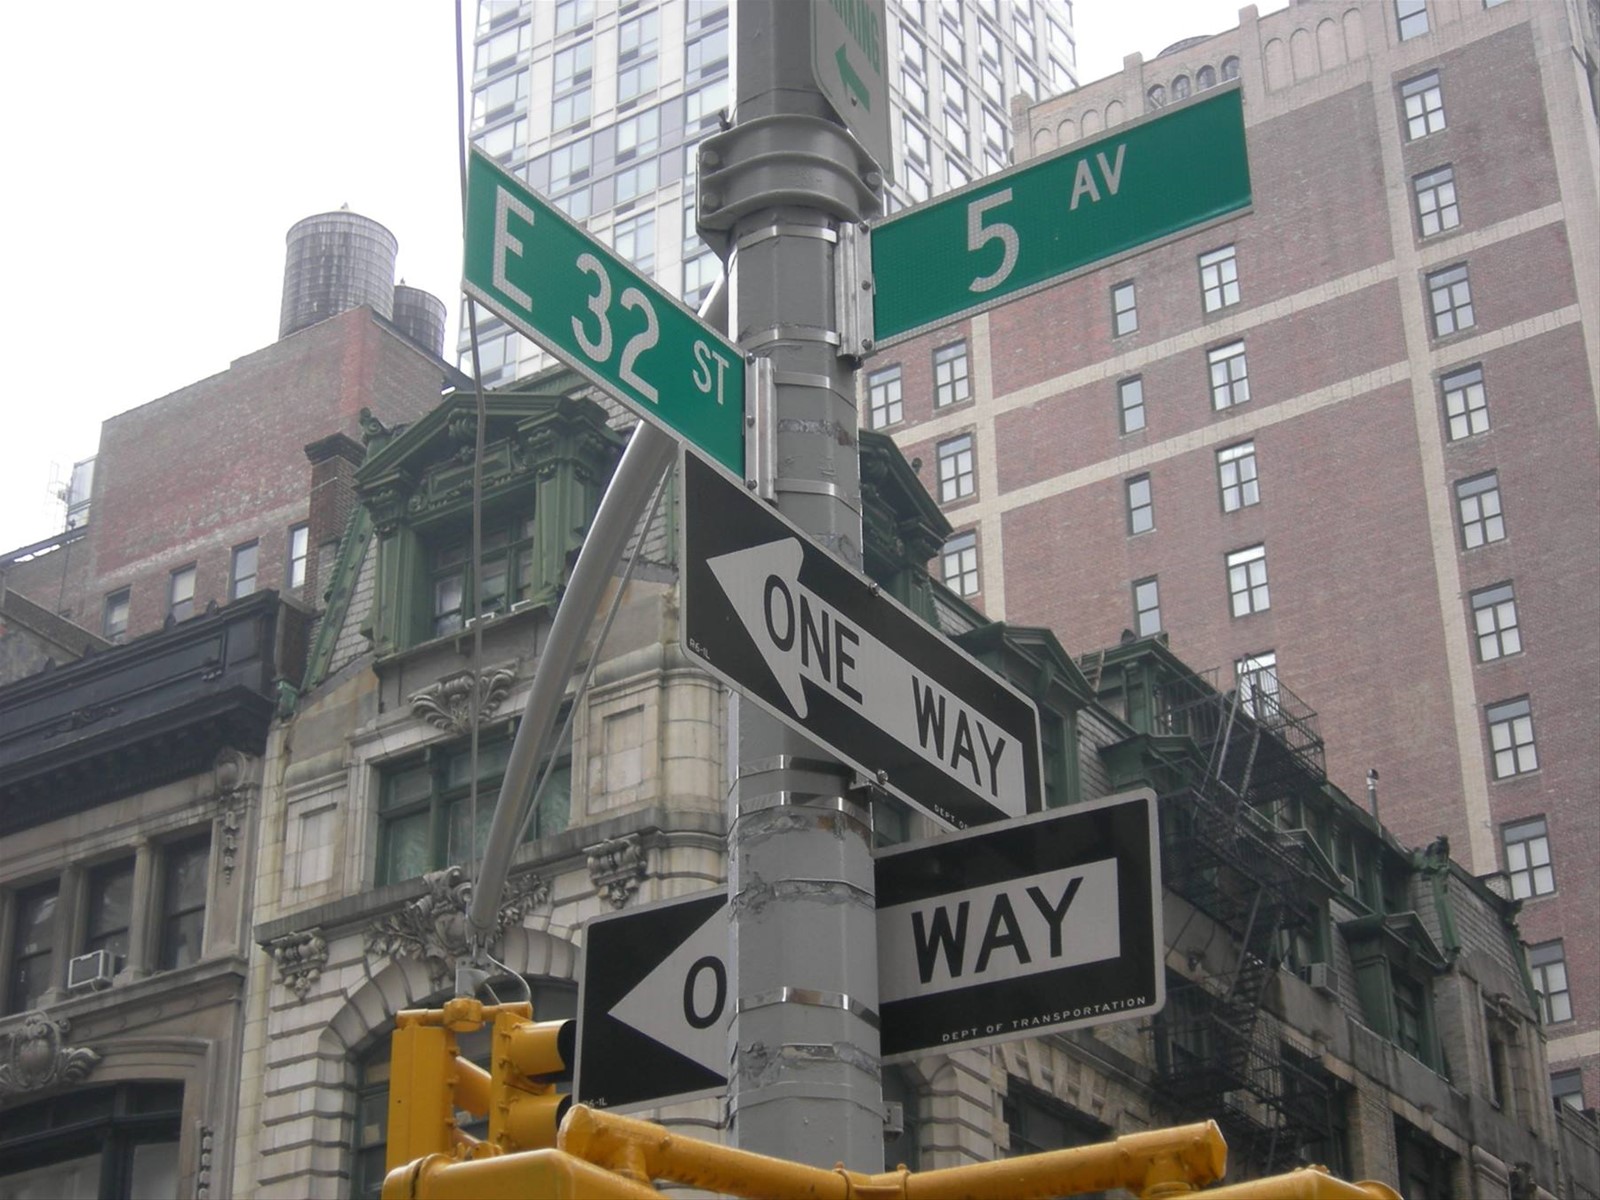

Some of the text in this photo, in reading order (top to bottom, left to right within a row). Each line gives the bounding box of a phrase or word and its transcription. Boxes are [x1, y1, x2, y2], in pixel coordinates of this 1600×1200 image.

[967, 144, 1127, 292] 5 AV
[492, 185, 730, 405] E 32 ST
[763, 574, 1007, 797] ONE WAY
[911, 876, 1085, 984] WAY
[942, 996, 1147, 1043] DEPT OF TRANSPORTATION
